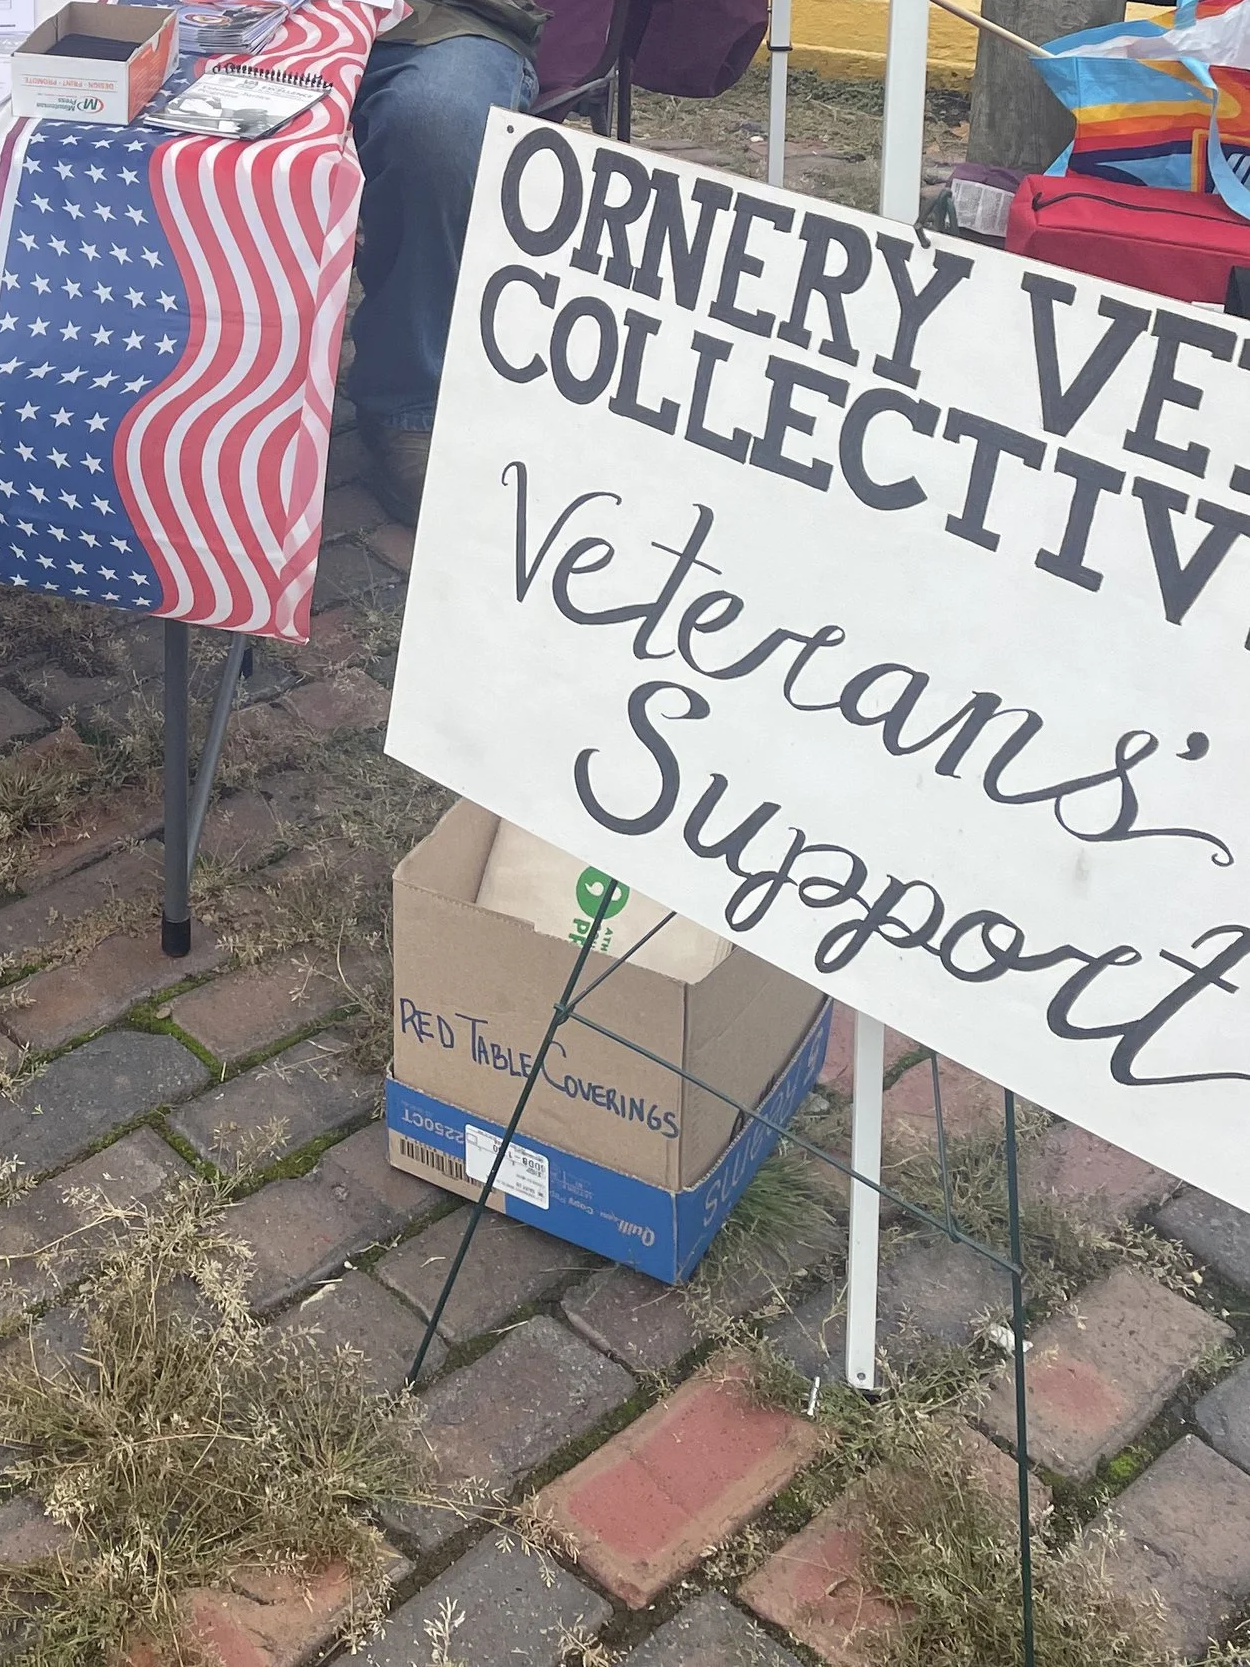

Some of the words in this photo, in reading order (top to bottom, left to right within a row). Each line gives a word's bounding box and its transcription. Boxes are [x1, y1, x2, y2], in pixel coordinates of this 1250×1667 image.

[24, 76, 58, 86] PROMOTE
[36, 102, 76, 112] Minuteman
[58, 97, 77, 106] Press
[62, 79, 83, 88] PRINT
[88, 81, 115, 90] DESIGN
[500, 126, 975, 390] ORNERY
[1020, 271, 1250, 499] VE
[479, 264, 1250, 652] COLLECTIV
[501, 461, 1234, 867] Veterans'
[573, 680, 1250, 1087] Support
[399, 997, 455, 1049] RED
[454, 1012, 534, 1079] TABLE
[540, 1039, 680, 1140] COVERINGS
